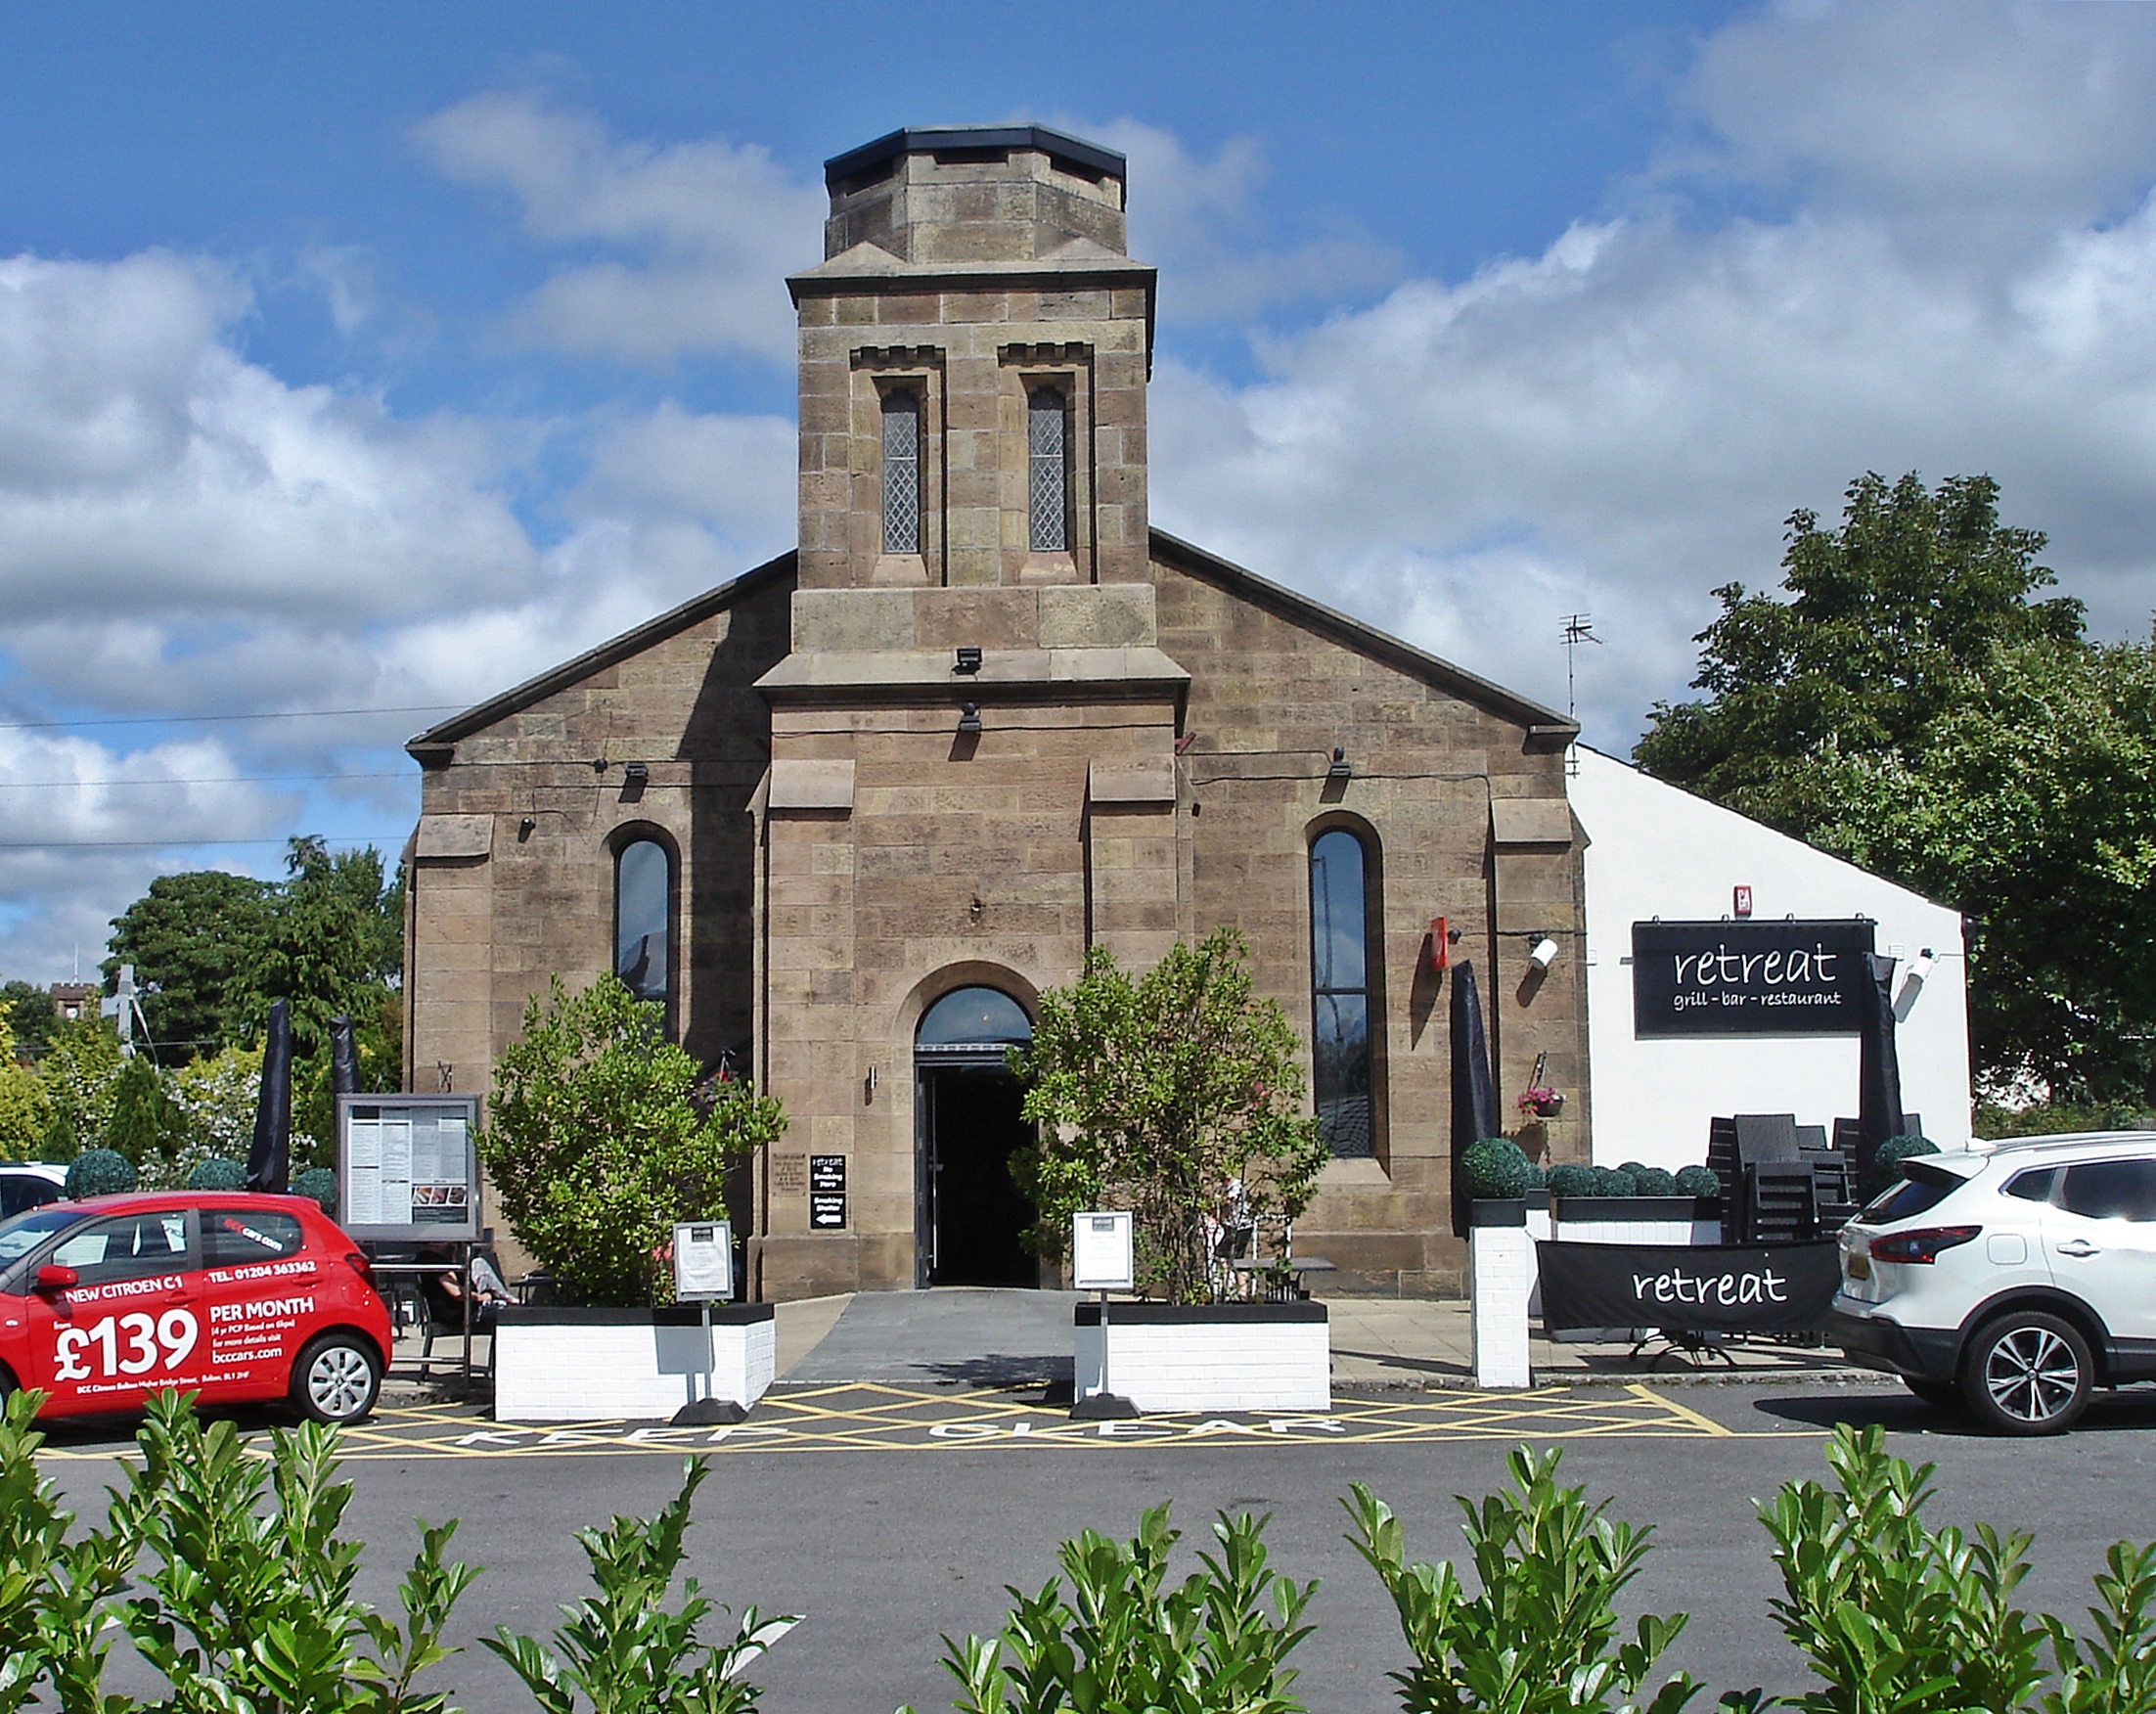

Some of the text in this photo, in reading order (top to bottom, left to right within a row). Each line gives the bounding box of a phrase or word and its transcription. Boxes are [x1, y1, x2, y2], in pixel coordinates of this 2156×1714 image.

[1675, 942, 1837, 985] retreat
[1674, 990, 1708, 1011] grill
[1722, 991, 1746, 1007] bar
[1761, 990, 1842, 1007] restaurant
[812, 1157, 843, 1166] retreat
[814, 1196, 843, 1205] Smoking
[208, 1260, 316, 1284] TEL. 01204 363362
[65, 1275, 183, 1303] NEW CITROEN C1
[1633, 1267, 1788, 1306] retreat
[210, 1296, 314, 1323] PER MONTH
[53, 1321, 72, 1330] from
[53, 1308, 199, 1381] £139
[244, 1333, 267, 1344] details
[212, 1347, 283, 1364] bcccars.com
[456, 1419, 1347, 1446] KEEP CLEAR
